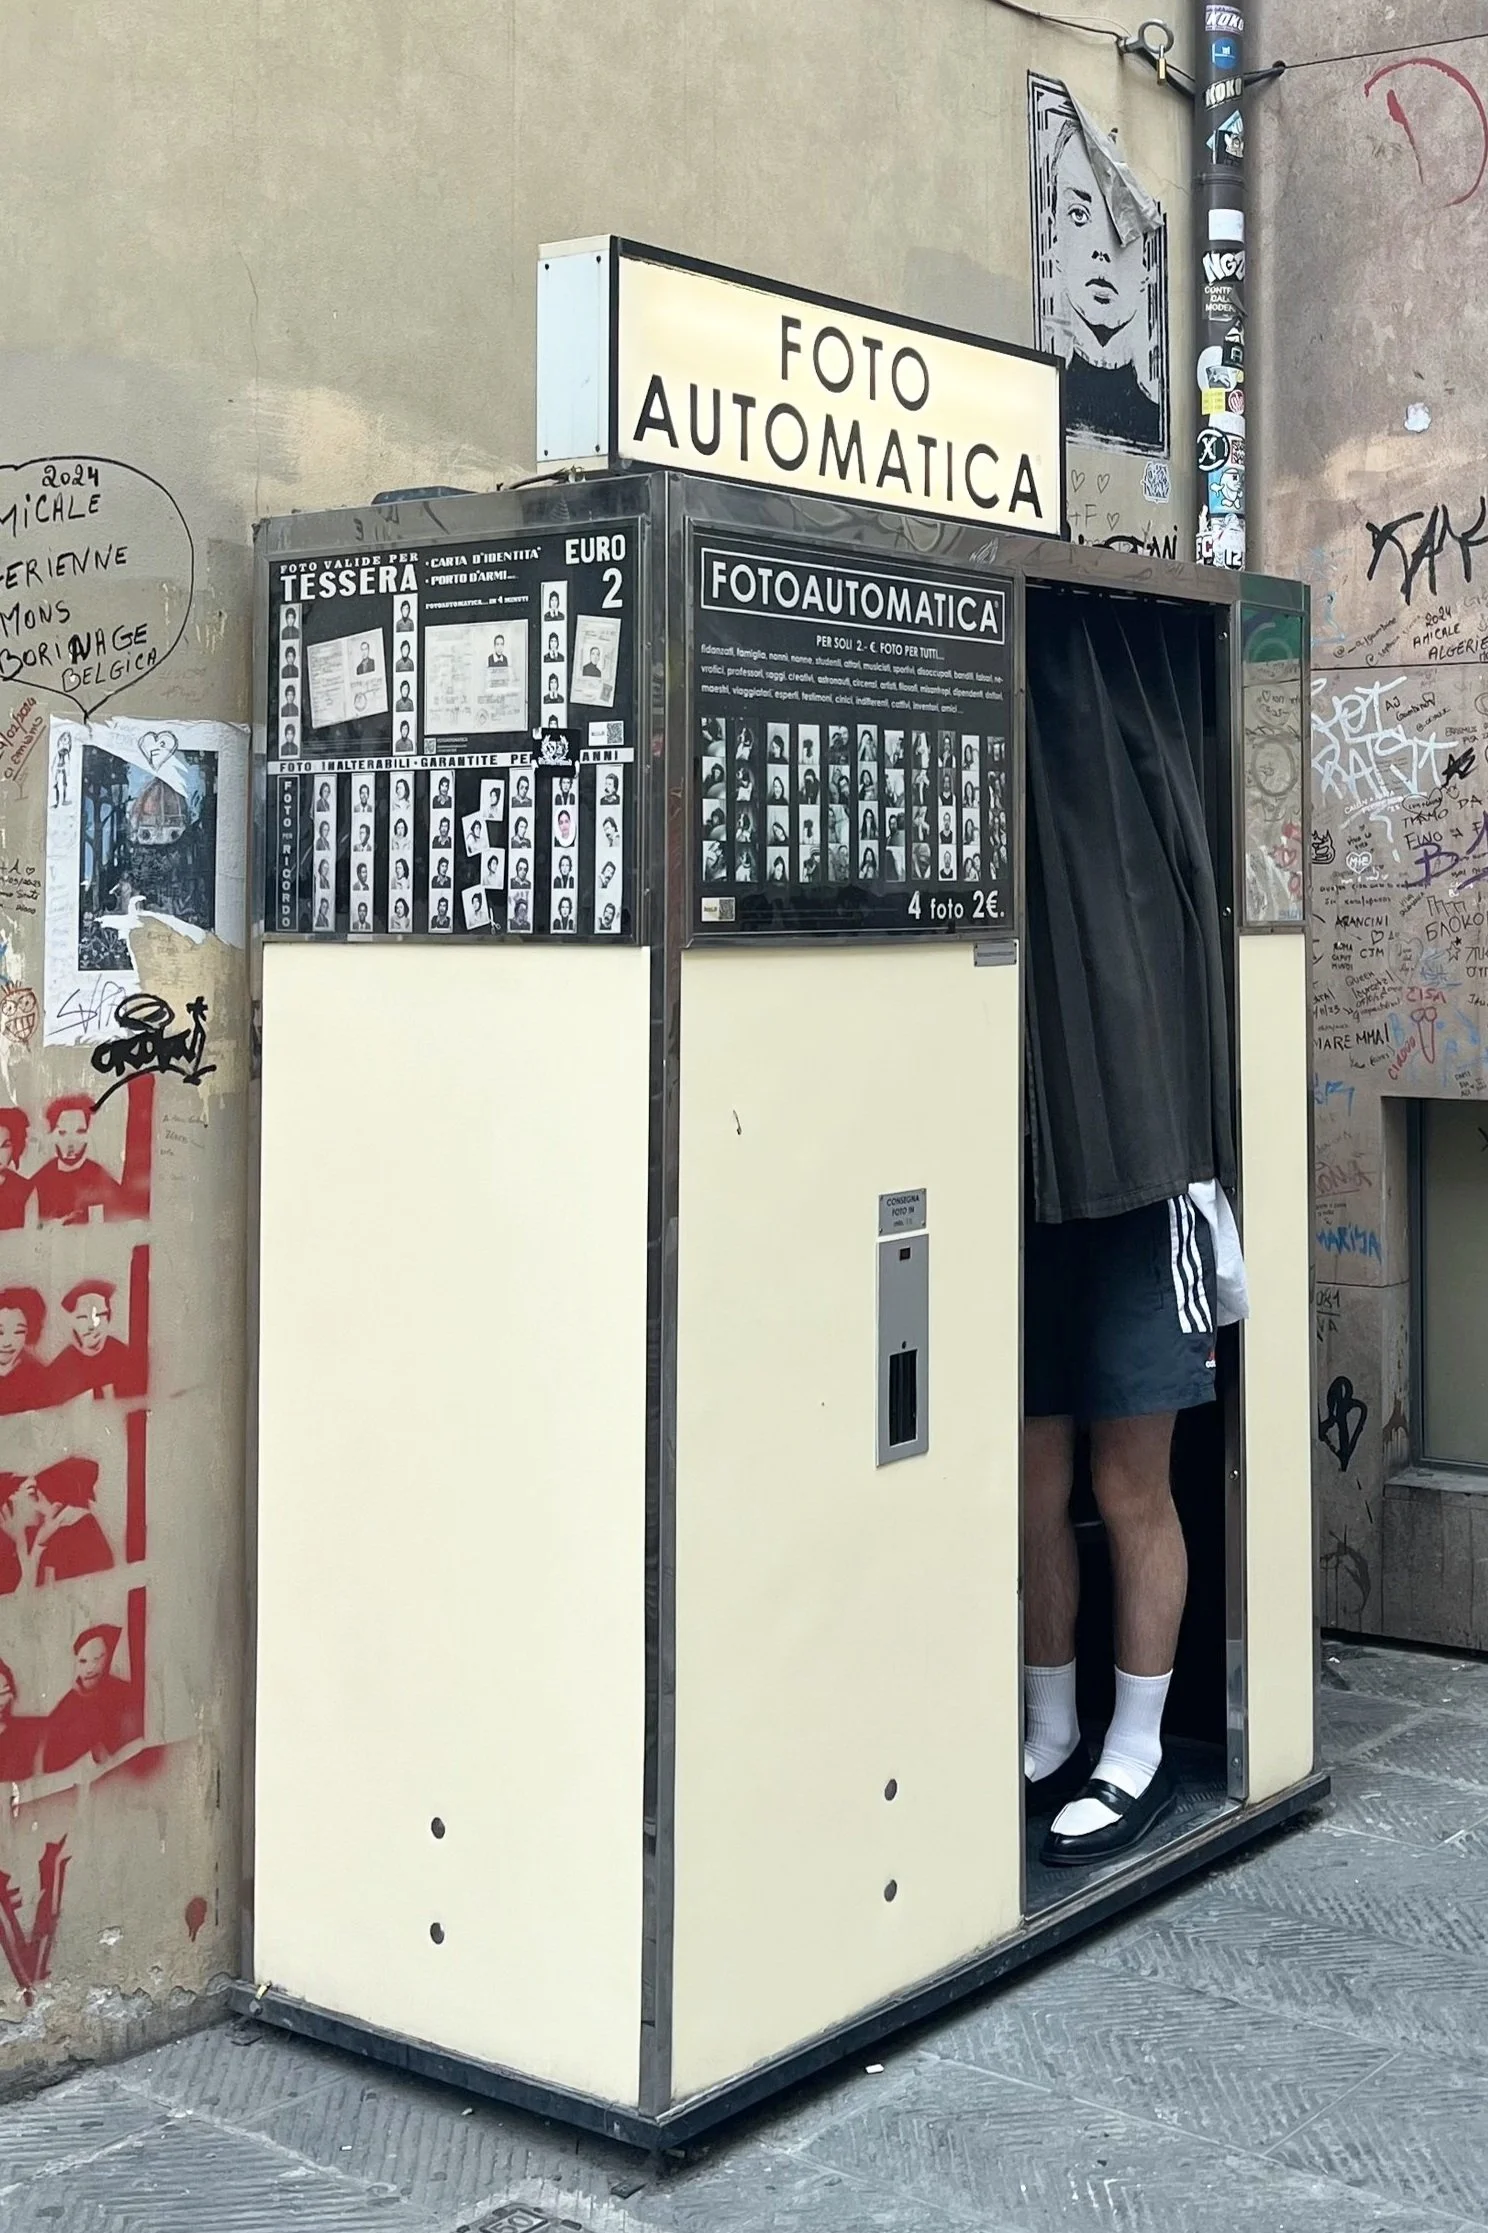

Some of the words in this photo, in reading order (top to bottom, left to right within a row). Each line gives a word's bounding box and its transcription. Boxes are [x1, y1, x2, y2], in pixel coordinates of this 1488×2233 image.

[781, 315, 930, 411] FOTO
[633, 373, 1043, 518] AUTOMATICA
[42, 464, 99, 487] 2024
[280, 562, 317, 574] FOTO
[324, 556, 381, 569] VALIDE
[389, 552, 418, 563] PER
[431, 556, 468, 568] CARTA
[565, 534, 626, 565] EURO
[280, 563, 418, 602] TESSERA
[431, 571, 468, 586] PORTO
[602, 568, 623, 609] 2
[712, 561, 998, 634] FOTOAUTOMATICA
[1, 600, 71, 638] MONS
[1425, 606, 1452, 627] 2024
[817, 635, 832, 648] PER
[834, 637, 852, 650] SOLI
[880, 642, 903, 656] FOTO
[904, 645, 919, 657] PER
[280, 762, 312, 772] FOTO
[322, 758, 410, 771] INALTERABILI
[421, 754, 498, 767] GARANTITE
[582, 751, 618, 761] ANNI
[282, 781, 292, 827] FOTO
[281, 844, 291, 927] RICORDO
[908, 890, 921, 919] 4
[930, 897, 964, 919] foto
[887, 1195, 919, 1206] CONSEGNA
[892, 1207, 907, 1216] FOTO
